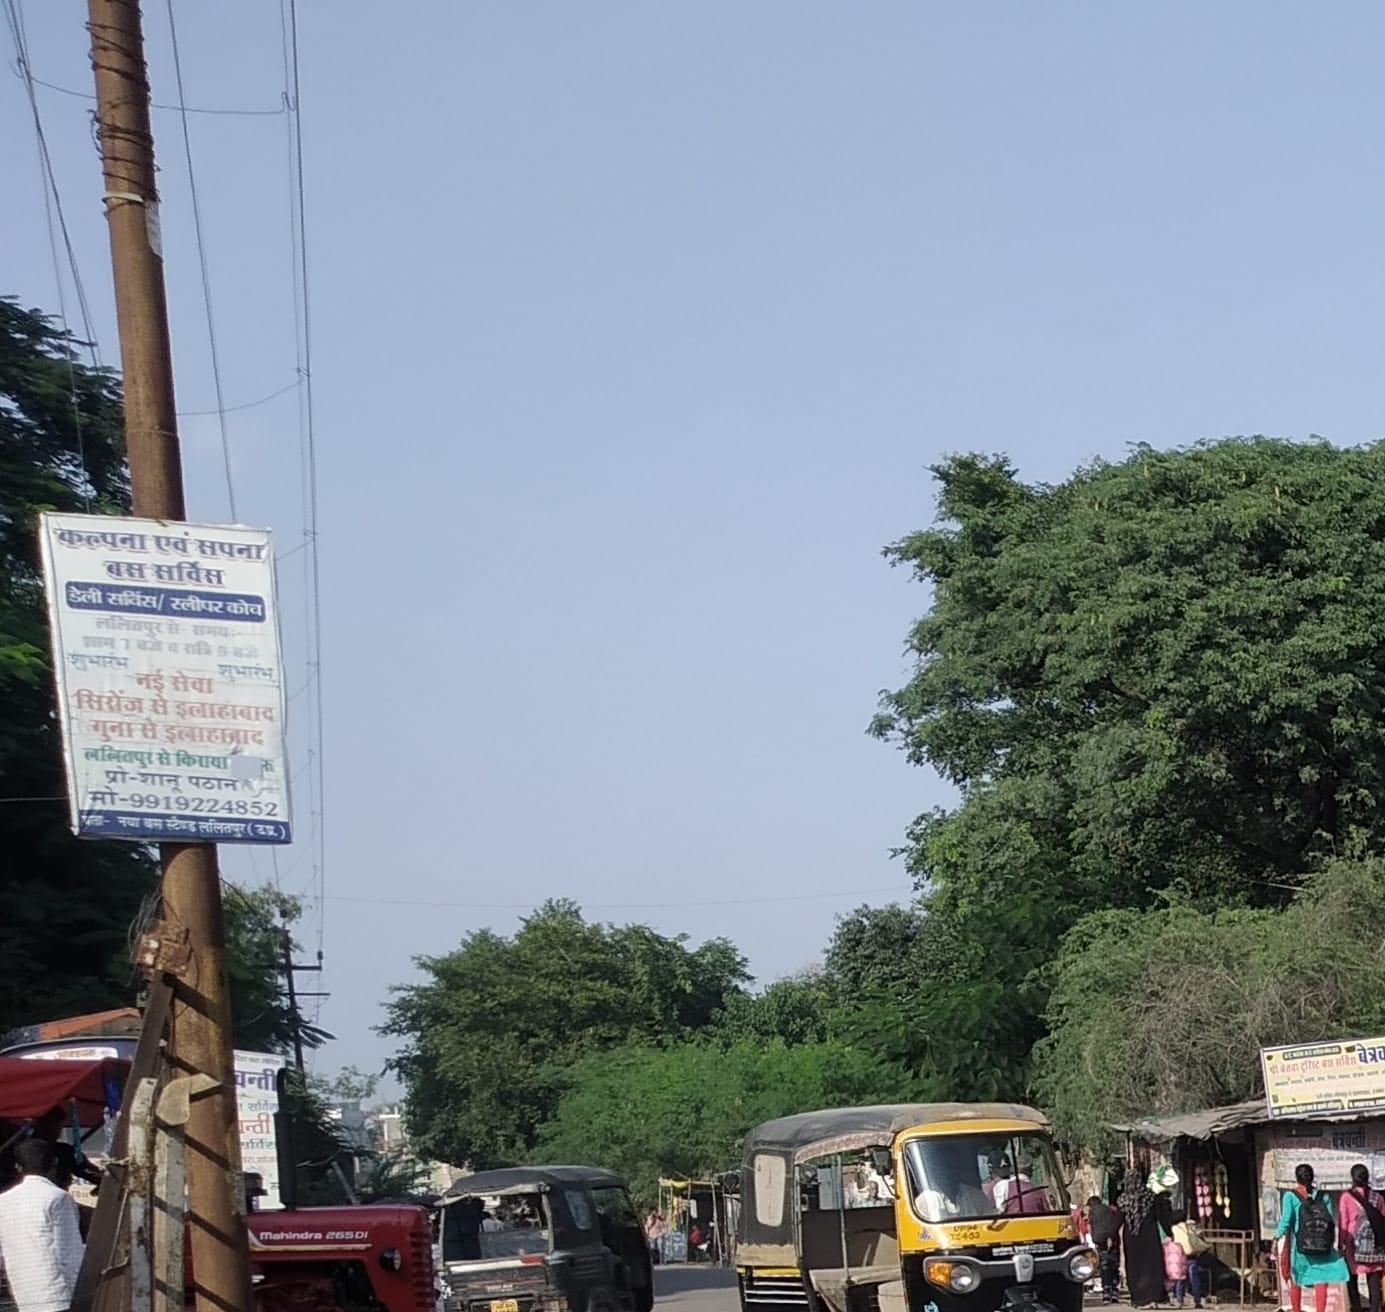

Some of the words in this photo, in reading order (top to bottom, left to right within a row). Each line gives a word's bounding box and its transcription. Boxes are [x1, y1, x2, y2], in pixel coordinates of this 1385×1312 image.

[54, 528, 147, 551] कल्पना
[151, 531, 191, 553] एवं
[194, 538, 267, 560] सपना
[104, 560, 148, 580] बस
[150, 561, 225, 585] सर्विस
[68, 586, 103, 604] डेली
[169, 597, 224, 613] स्लीपर
[226, 599, 263, 617] कोच
[68, 651, 129, 671] शुभारंभ
[218, 663, 273, 682] शुभारंभ
[136, 669, 165, 692] नई
[171, 671, 214, 694] सेवा
[76, 689, 144, 713] सिरोंज
[151, 694, 168, 715] से
[176, 700, 274, 723] इलाहाबाद
[92, 719, 135, 741] गुना
[142, 718, 158, 740] से
[84, 745, 153, 768] ललितपुर
[157, 748, 170, 766] से
[188, 776, 239, 791] पठान
[260, 1231, 322, 1240] Mahindra
